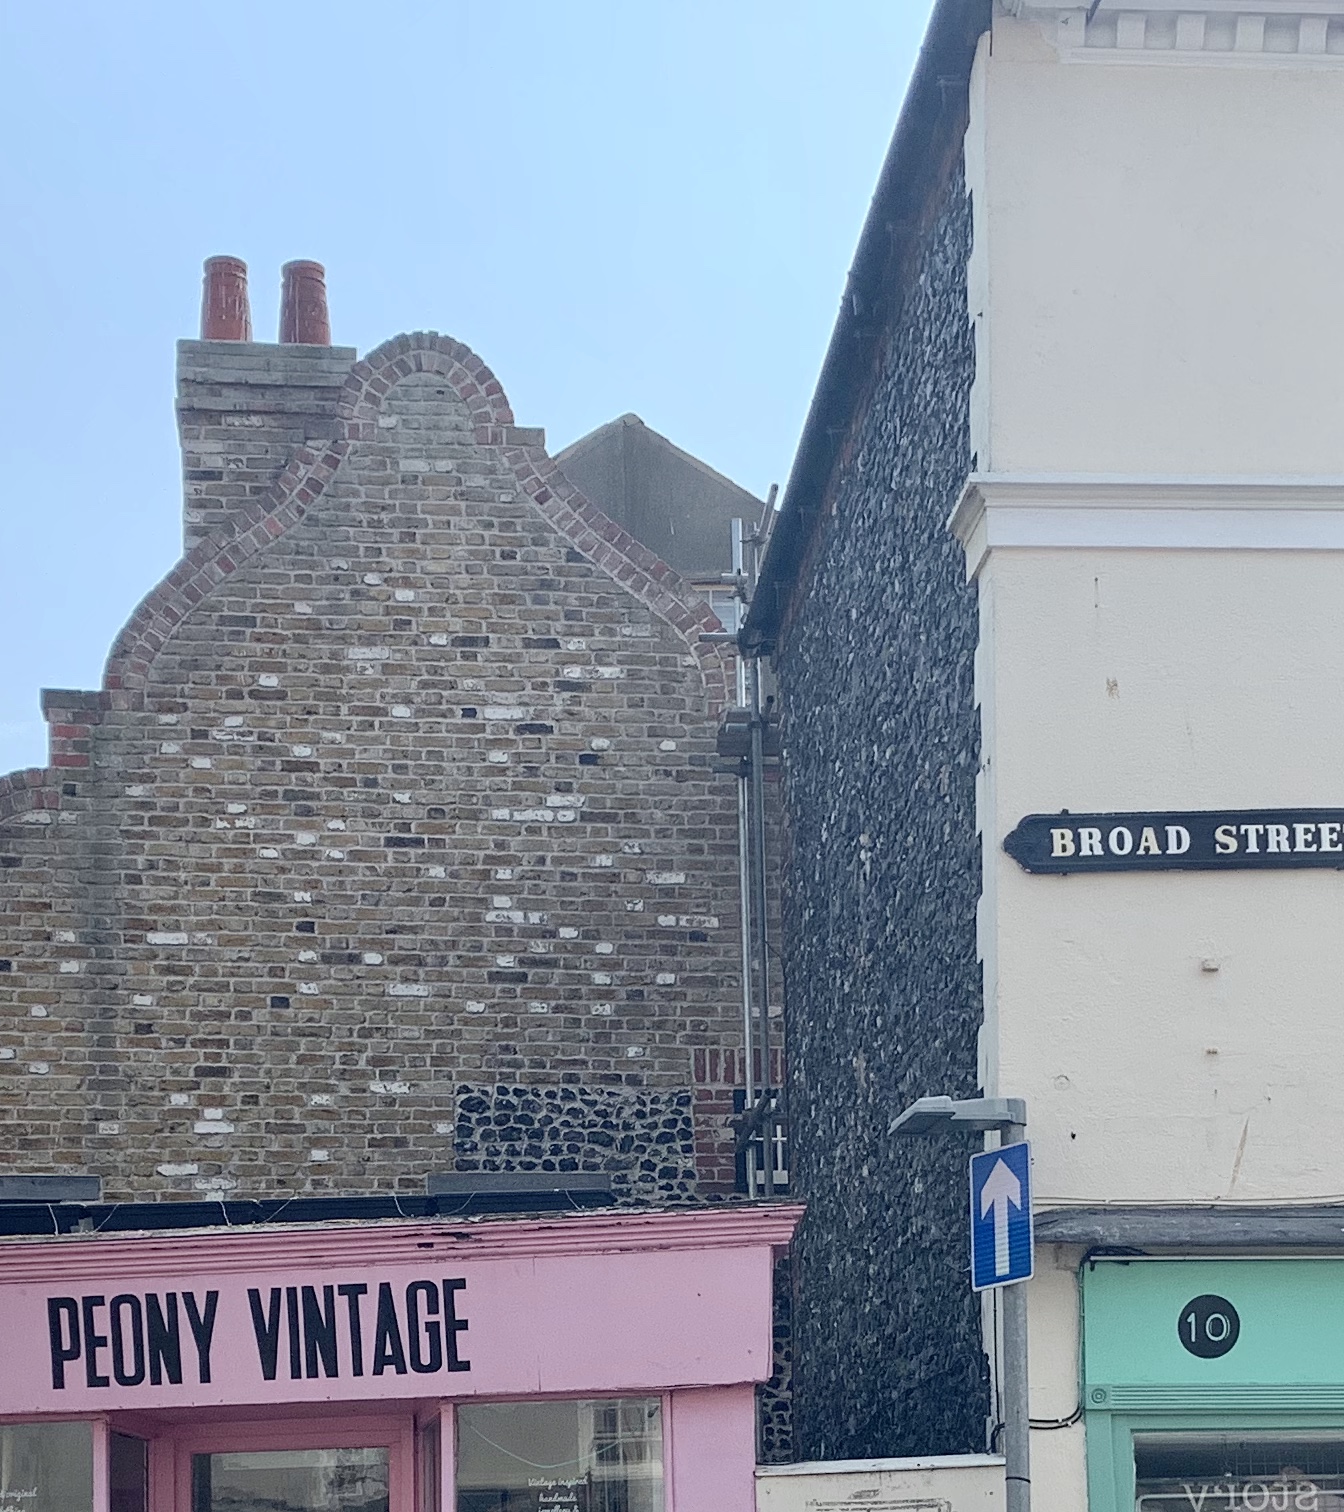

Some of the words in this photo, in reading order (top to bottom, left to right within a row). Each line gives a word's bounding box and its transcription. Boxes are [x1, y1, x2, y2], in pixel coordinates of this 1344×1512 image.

[1049, 825, 1191, 857] BROAD
[47, 1290, 220, 1389] PEONY
[248, 1278, 471, 1381] VINTAGE
[1186, 1311, 1231, 1342] 10
